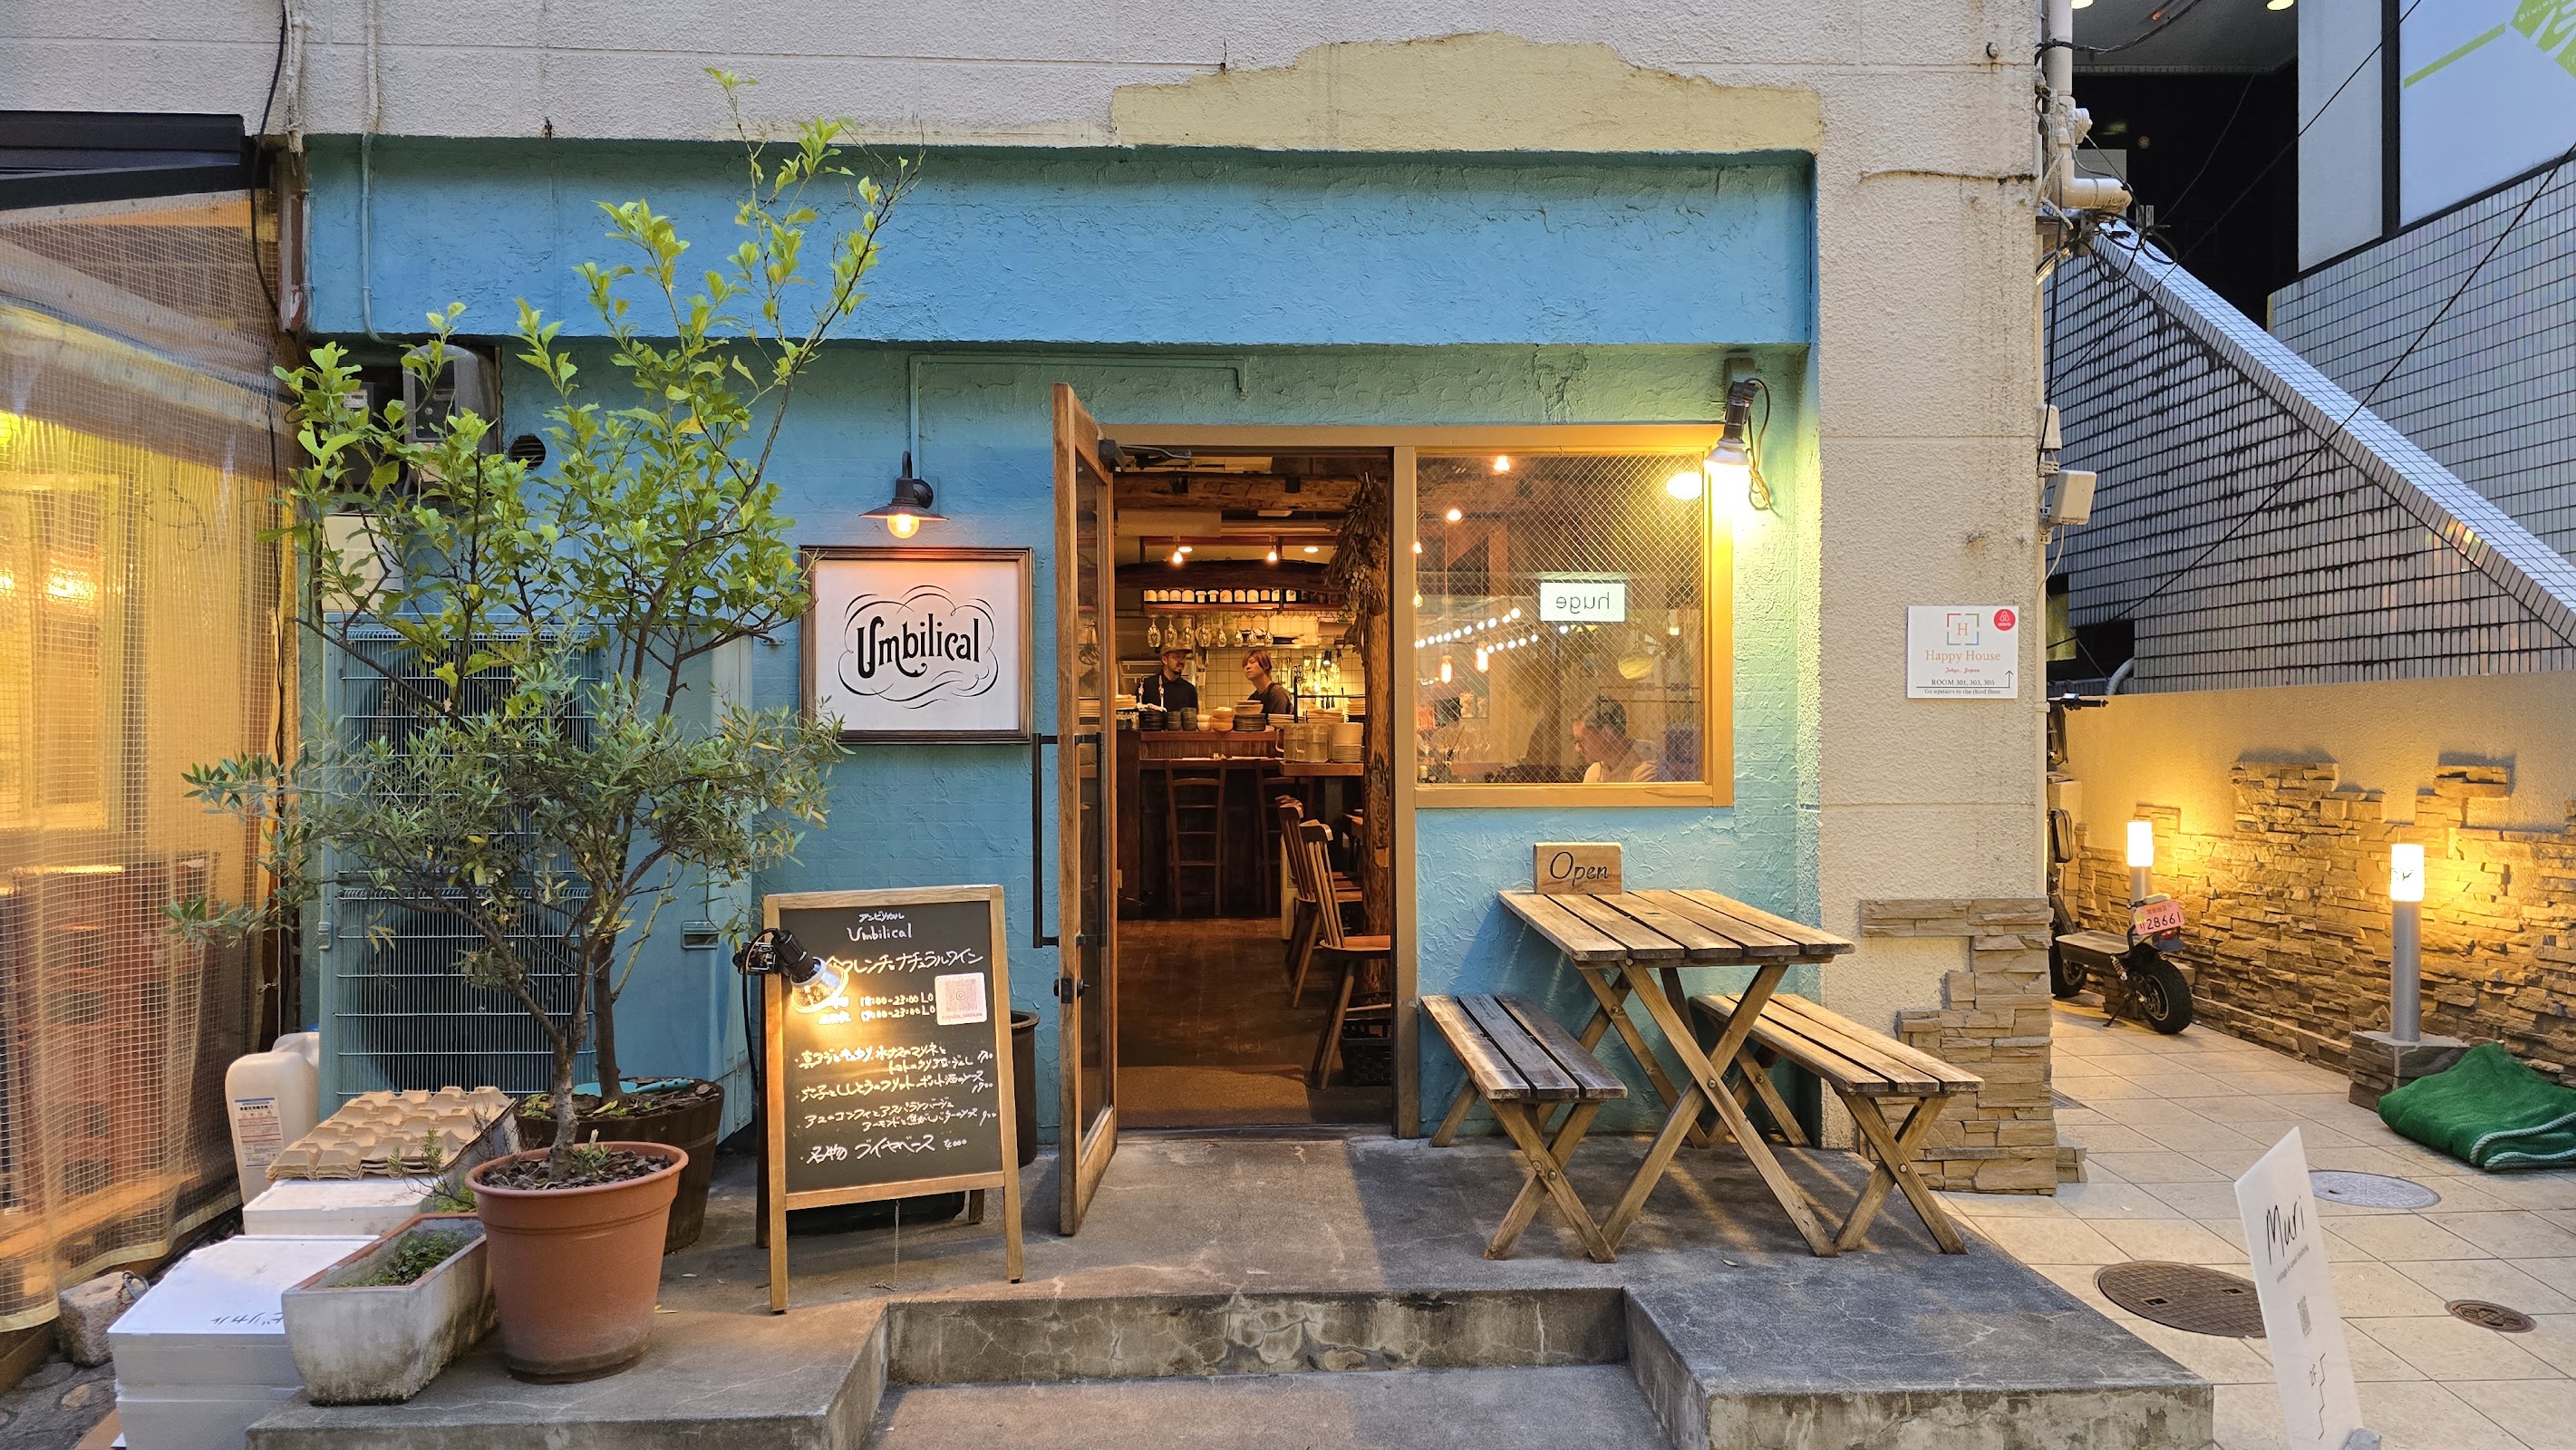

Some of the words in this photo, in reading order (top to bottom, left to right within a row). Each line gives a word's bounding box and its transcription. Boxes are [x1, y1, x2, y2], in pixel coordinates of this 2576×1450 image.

[1957, 623, 1969, 636] H
[857, 614, 980, 679] Umbilical
[1925, 650, 1962, 663] Happy
[1965, 650, 2001, 662] House
[1549, 851, 1609, 887] Open
[2145, 911, 2182, 931] 28661
[847, 923, 912, 942] Umbilical
[2265, 1195, 2305, 1265] Muri
